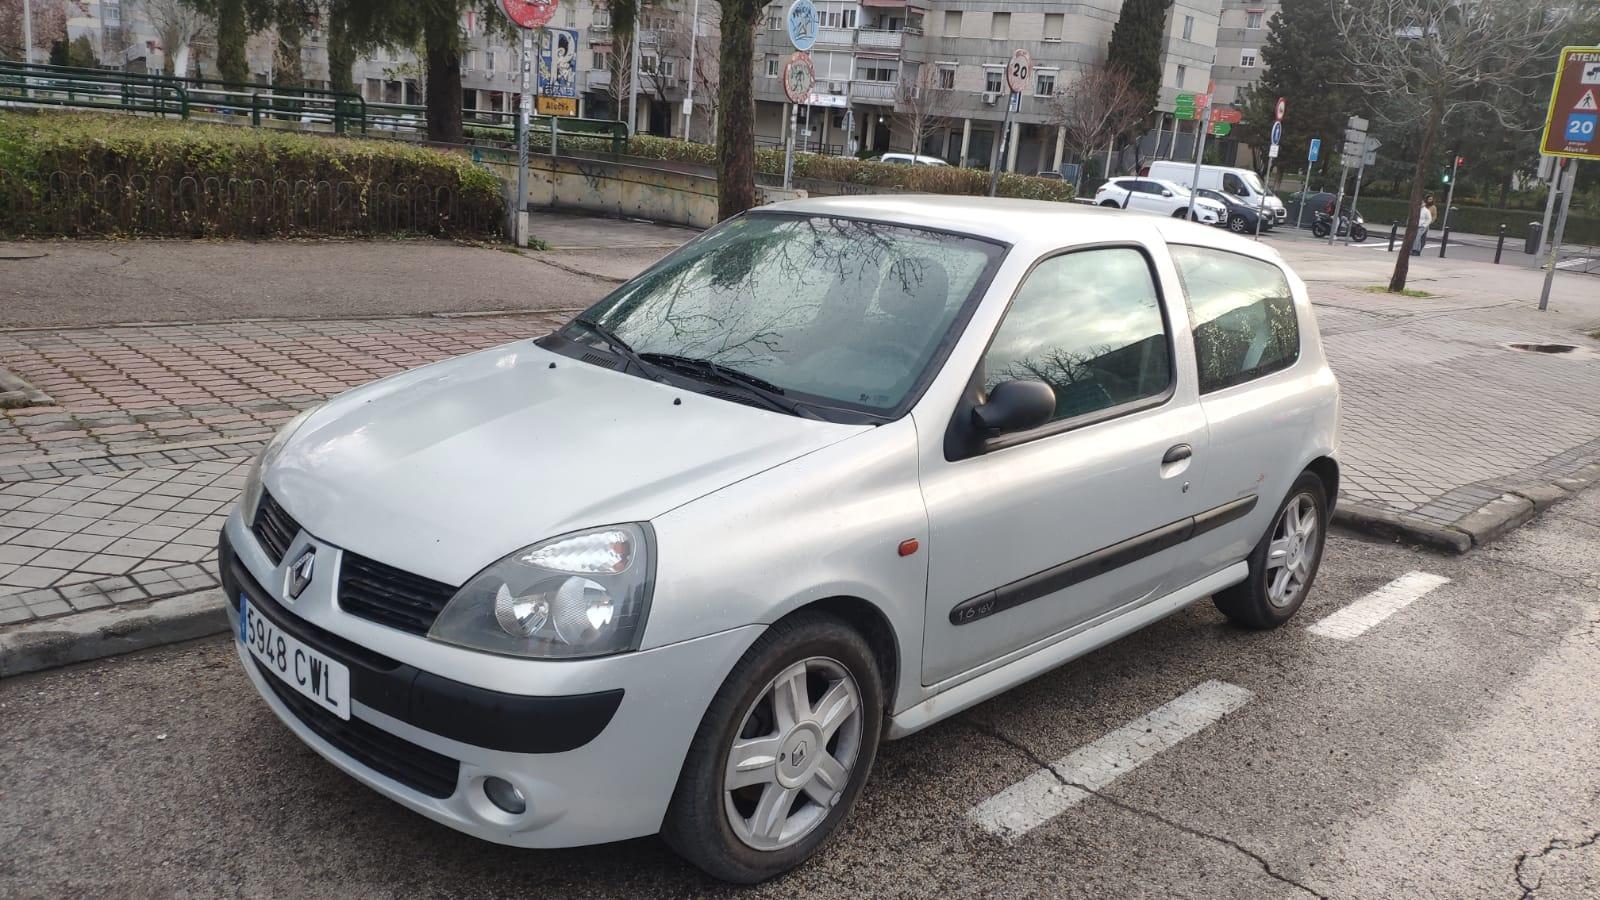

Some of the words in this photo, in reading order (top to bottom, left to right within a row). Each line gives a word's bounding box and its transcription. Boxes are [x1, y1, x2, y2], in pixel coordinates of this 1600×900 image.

[1568, 52, 1600, 61] ATEN
[1013, 63, 1027, 79] 20
[1569, 121, 1593, 134] 20
[247, 608, 287, 673] 5948
[294, 648, 338, 707] CWL
